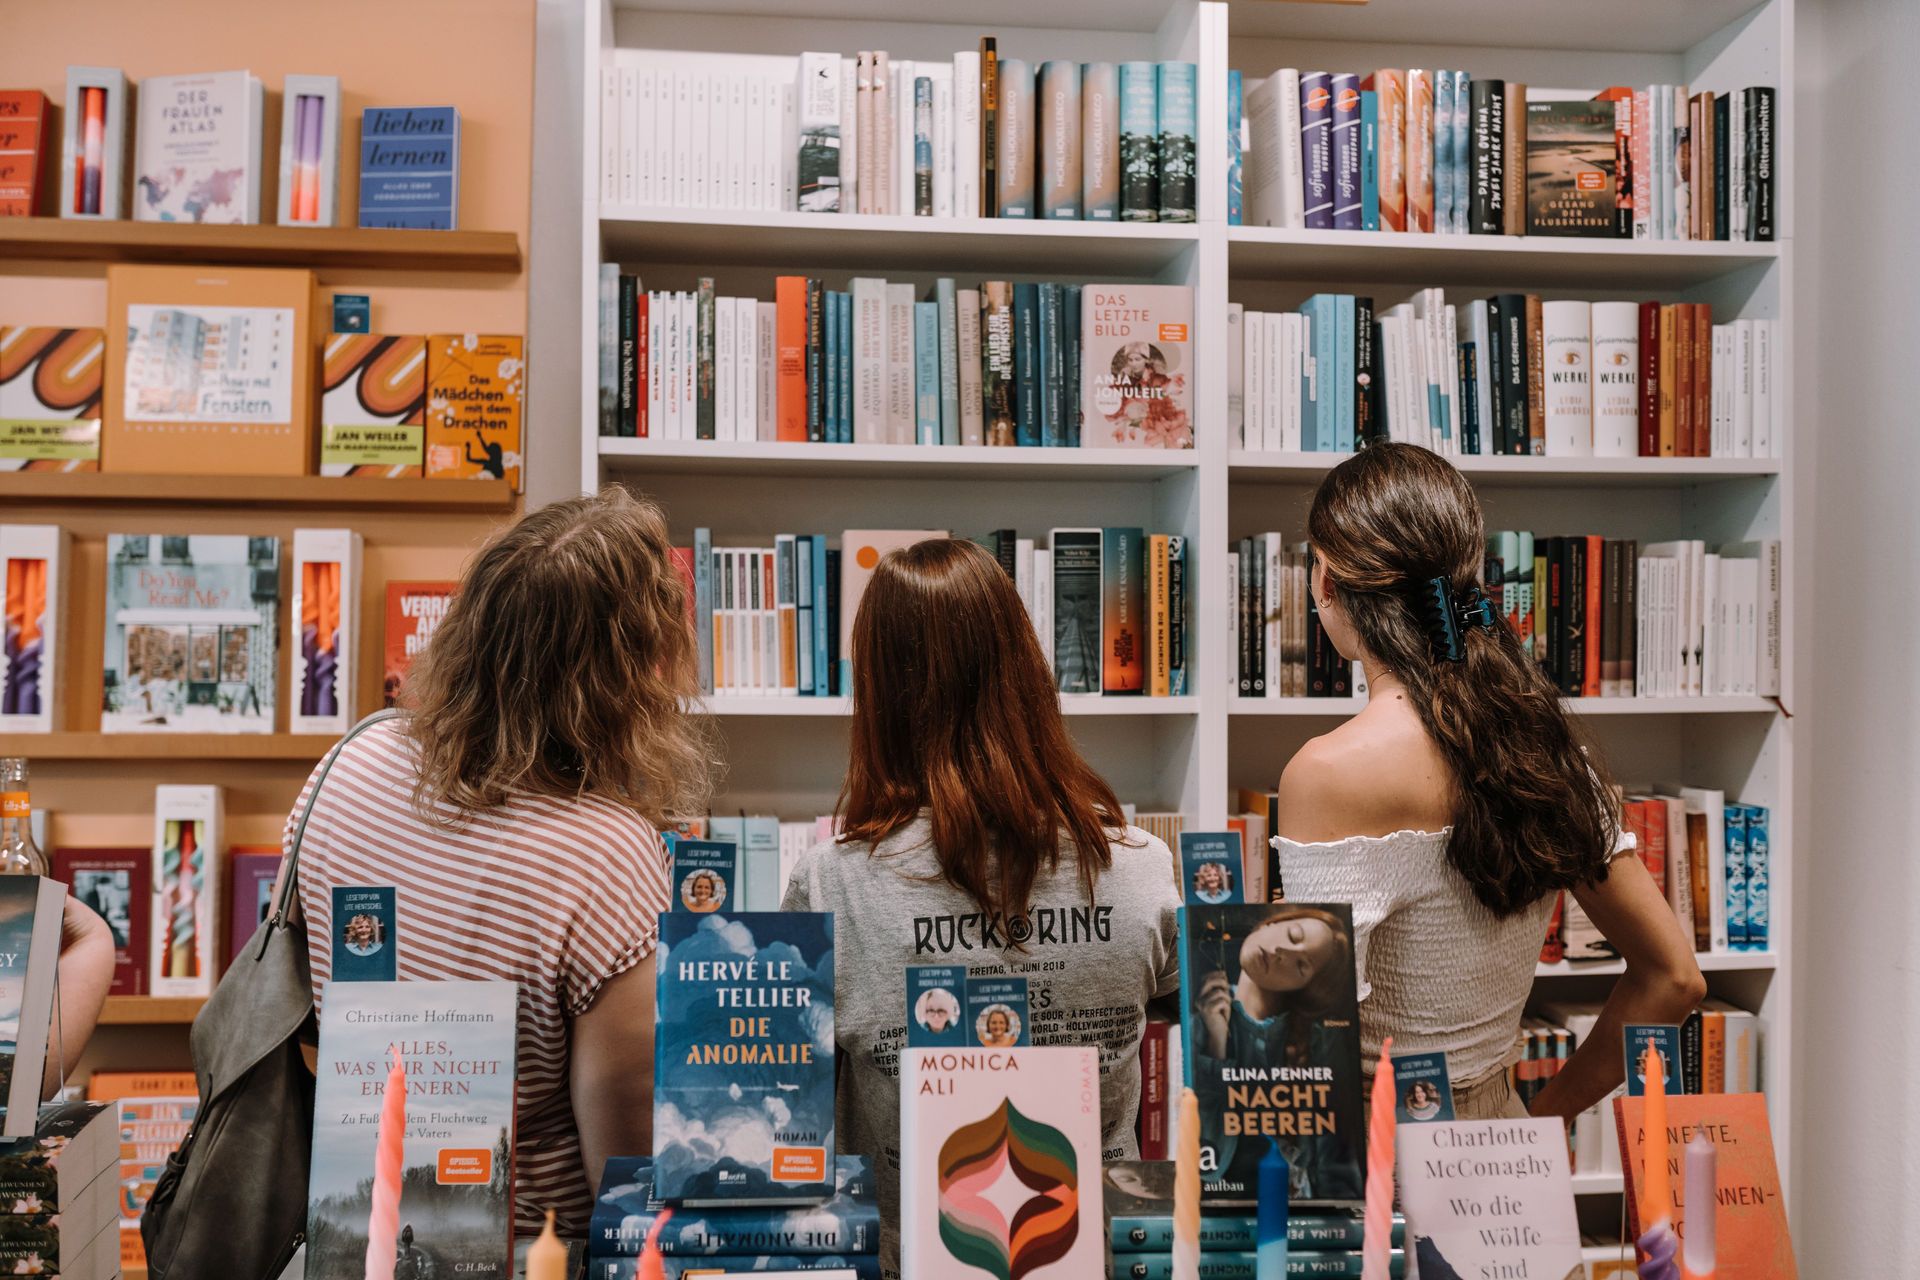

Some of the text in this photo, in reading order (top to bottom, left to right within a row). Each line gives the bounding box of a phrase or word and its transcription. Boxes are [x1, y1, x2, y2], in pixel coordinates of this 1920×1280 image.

[177, 91, 207, 104] DER
[163, 107, 223, 119] FRAUEN
[170, 121, 216, 134] ATLAS
[373, 112, 445, 134] lieben
[1758, 93, 1770, 180] Glitterschnitter
[370, 144, 446, 166] lernen
[1490, 93, 1503, 210] ZWEI JAHRE NACHT
[1478, 154, 1489, 196] DAMIR
[1562, 192, 1583, 200] DER
[1550, 200, 1595, 209] GESANG
[1562, 209, 1583, 218] DER
[1095, 294, 1127, 306] DAS
[1095, 309, 1150, 322] LETZTE
[861, 298, 870, 358] REVOLUTION
[1095, 325, 1130, 337] BILD
[989, 333, 1000, 355] LIED
[470, 375, 490, 385] Das
[1094, 374, 1132, 386] ANJA
[1510, 366, 1521, 385] DAS
[1553, 372, 1588, 384] WERKE
[1601, 372, 1636, 384] WERKE
[433, 387, 504, 401] Mädchen
[1094, 386, 1163, 400] JONULEIT
[465, 404, 512, 414] mit dem
[444, 416, 508, 430] Drachen
[336, 432, 360, 441] JAN
[1157, 628, 1165, 678] NACHRICHT
[1037, 906, 1113, 945] RING
[679, 956, 792, 981] HERVÉ LE
[1020, 963, 1040, 973] JUNI
[1042, 961, 1065, 971] 2018
[716, 988, 811, 1008] TELLIER
[346, 1010, 494, 1023] Christiane Hoffmann
[1041, 1010, 1064, 1021] SOUR
[1080, 1007, 1114, 1018] PERFECT
[1115, 1004, 1139, 1015] CIRCLE
[730, 1017, 771, 1037] DIE
[1066, 1019, 1114, 1032] HOLLYWOOD
[1050, 1034, 1073, 1044] DAVIS
[1080, 1030, 1114, 1042] WALKING
[385, 1041, 453, 1056] ALLES,
[686, 1044, 813, 1065] ANOMALIE
[873, 1041, 898, 1054] ALT-J
[335, 1062, 376, 1075] WAS
[433, 1061, 501, 1075] NICHT
[919, 1054, 1019, 1072] MONICA
[1221, 1066, 1334, 1082] ELINA PENNER
[920, 1079, 955, 1095] ALI
[1080, 1052, 1093, 1114] ROMAN
[1227, 1083, 1331, 1109] NACHT
[341, 1114, 355, 1125] Zu
[431, 1113, 488, 1125] Fluchtweg
[1223, 1111, 1336, 1136] BEEREN
[419, 1129, 452, 1139] Vaters
[774, 1132, 817, 1142] ROMAN
[1433, 1126, 1538, 1149] Charlotte
[1425, 1154, 1553, 1179] McConaghy
[1204, 1178, 1245, 1192] aufbau
[1449, 1196, 1523, 1218] Wo die
[695, 1232, 836, 1248] DIE ANOMALIE
[1479, 1226, 1542, 1248] Wölfe
[454, 1262, 498, 1273] C.H.Beck
[1481, 1259, 1528, 1280] sind
